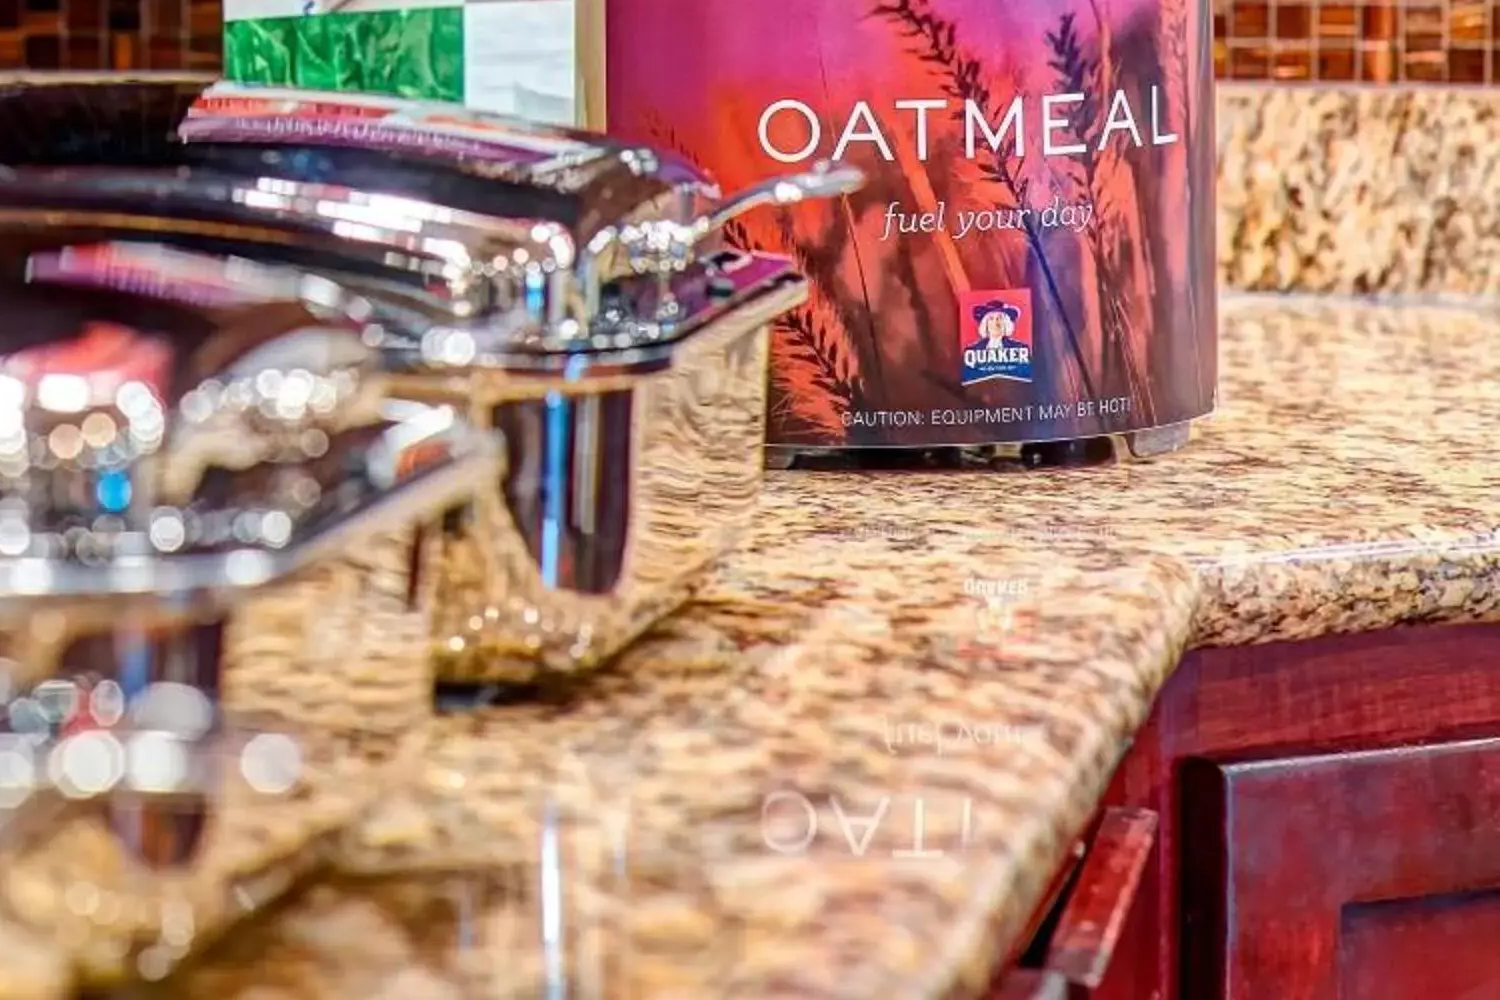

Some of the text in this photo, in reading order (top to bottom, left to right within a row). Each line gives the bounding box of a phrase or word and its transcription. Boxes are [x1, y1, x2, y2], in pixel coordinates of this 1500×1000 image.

[757, 85, 1179, 163] OATMEAL
[881, 196, 1095, 240] fuel your day
[964, 347, 1030, 369] QUAKER
[841, 397, 1131, 427] CAUTION: EQUIPMENT MAY BE HOT!
